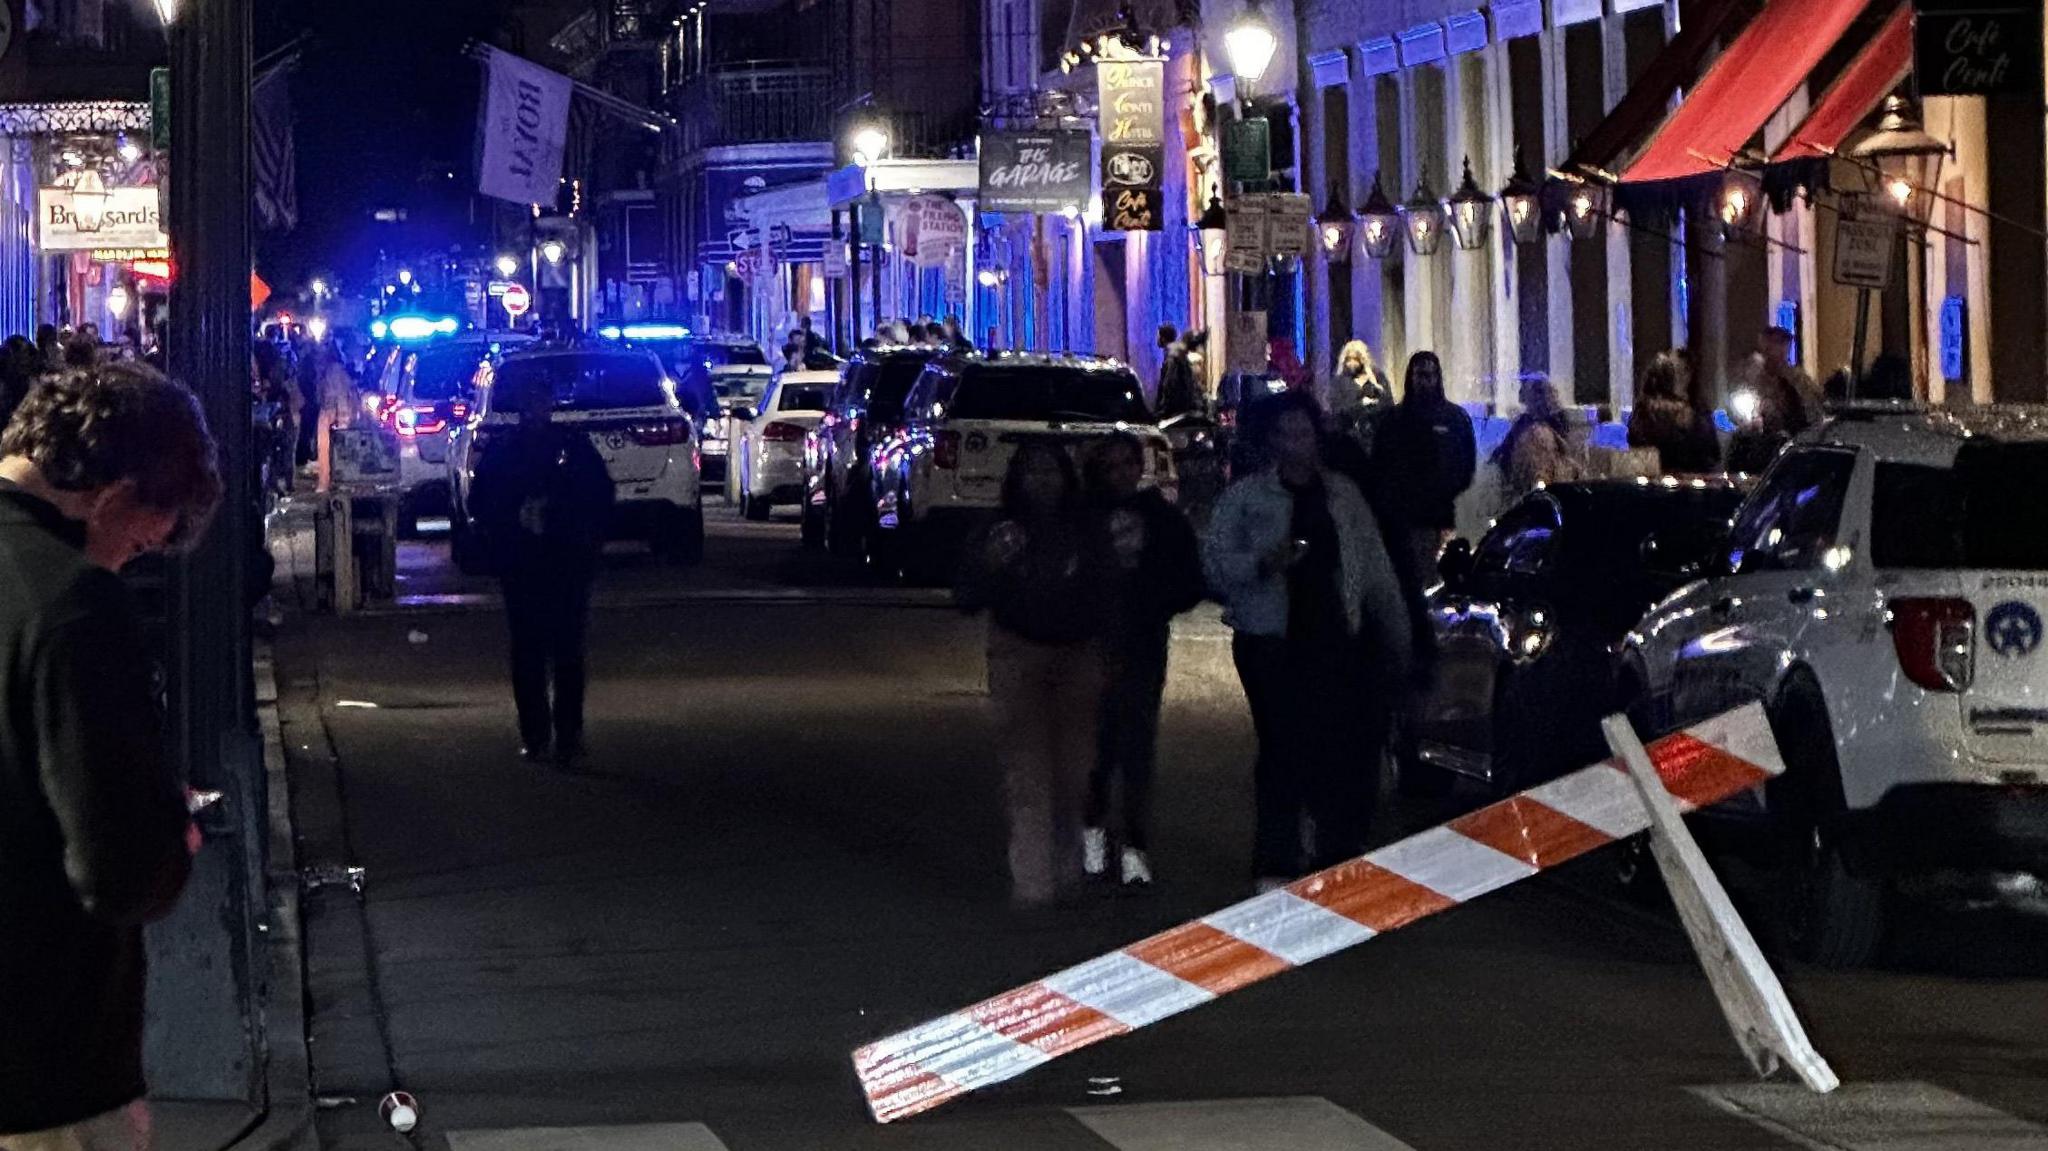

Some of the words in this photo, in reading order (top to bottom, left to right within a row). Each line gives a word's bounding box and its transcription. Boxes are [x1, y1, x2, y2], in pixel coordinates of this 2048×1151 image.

[989, 161, 1080, 188] GARAGE
[49, 204, 160, 227] Brsard's
[922, 221, 964, 233] STATION
